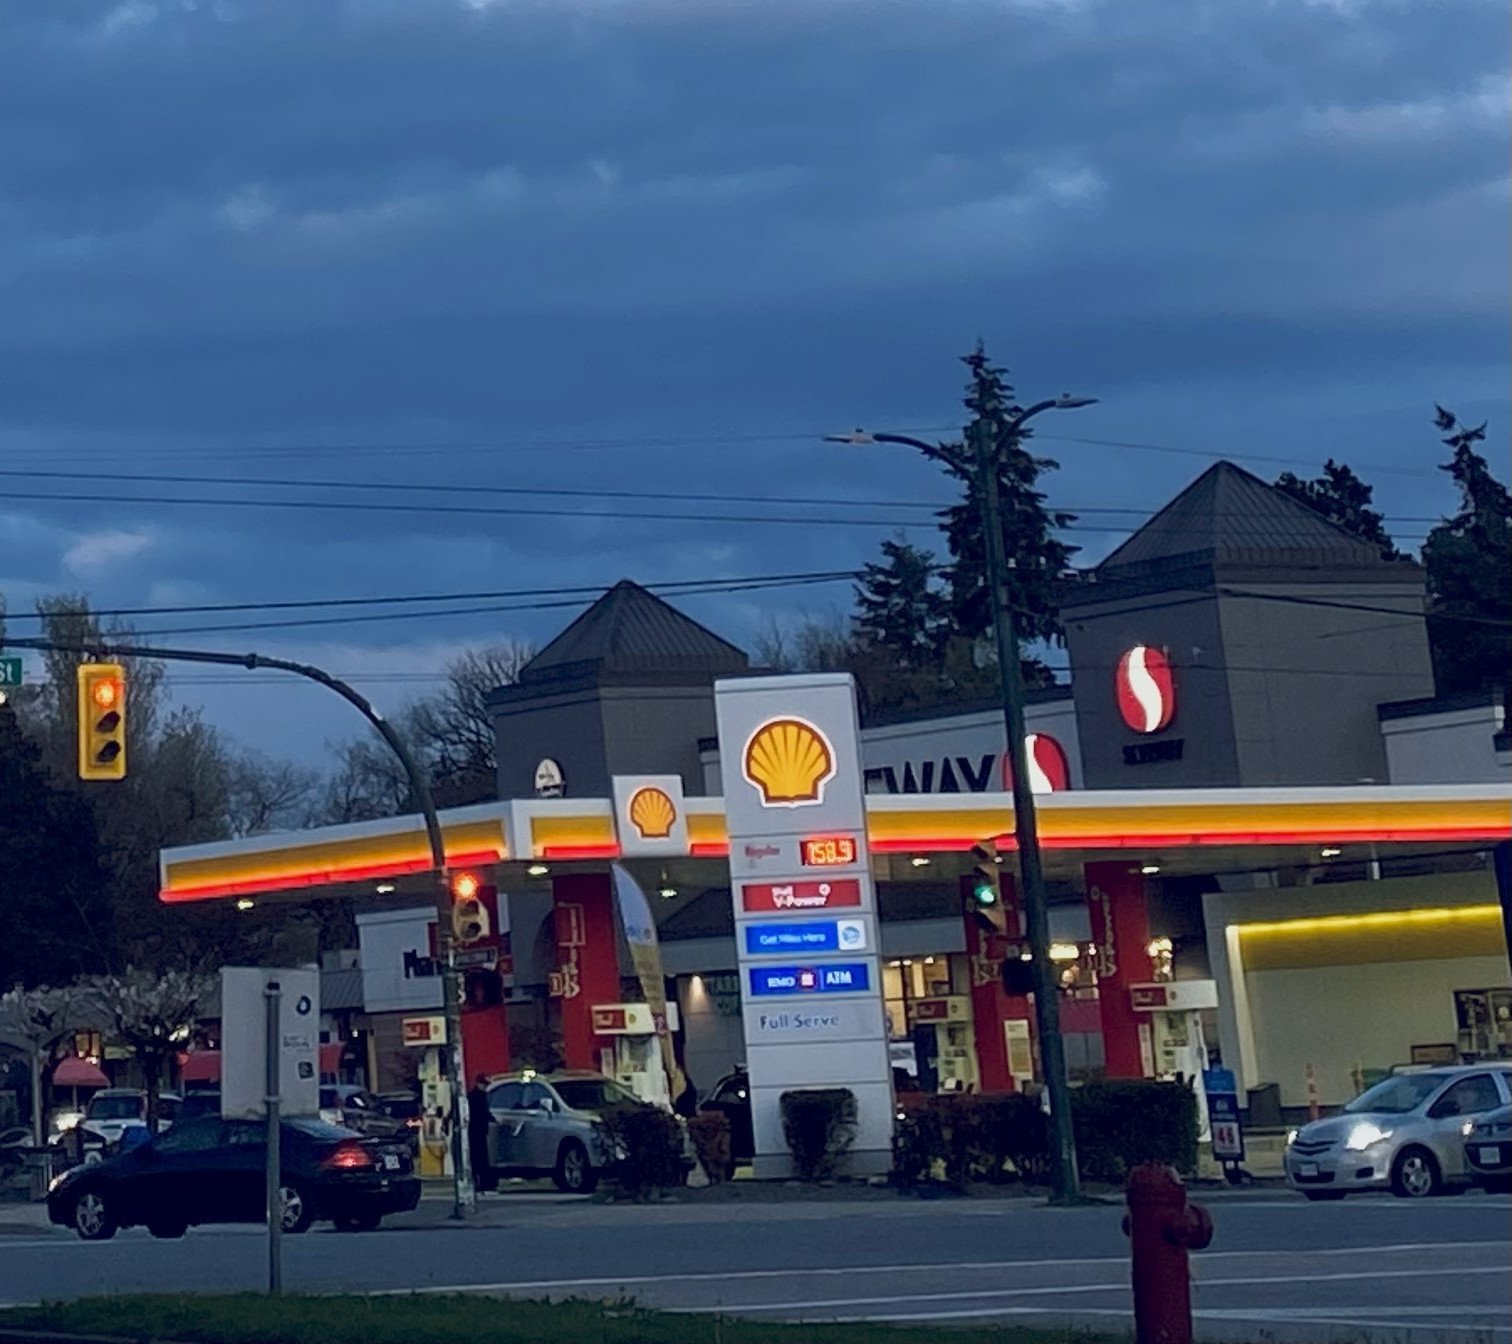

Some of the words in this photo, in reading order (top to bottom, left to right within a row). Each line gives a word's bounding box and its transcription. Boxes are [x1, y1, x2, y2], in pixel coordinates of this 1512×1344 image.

[826, 970, 853, 985] ATM
[759, 1014, 790, 1031] Full
[794, 1013, 840, 1029] Serve
